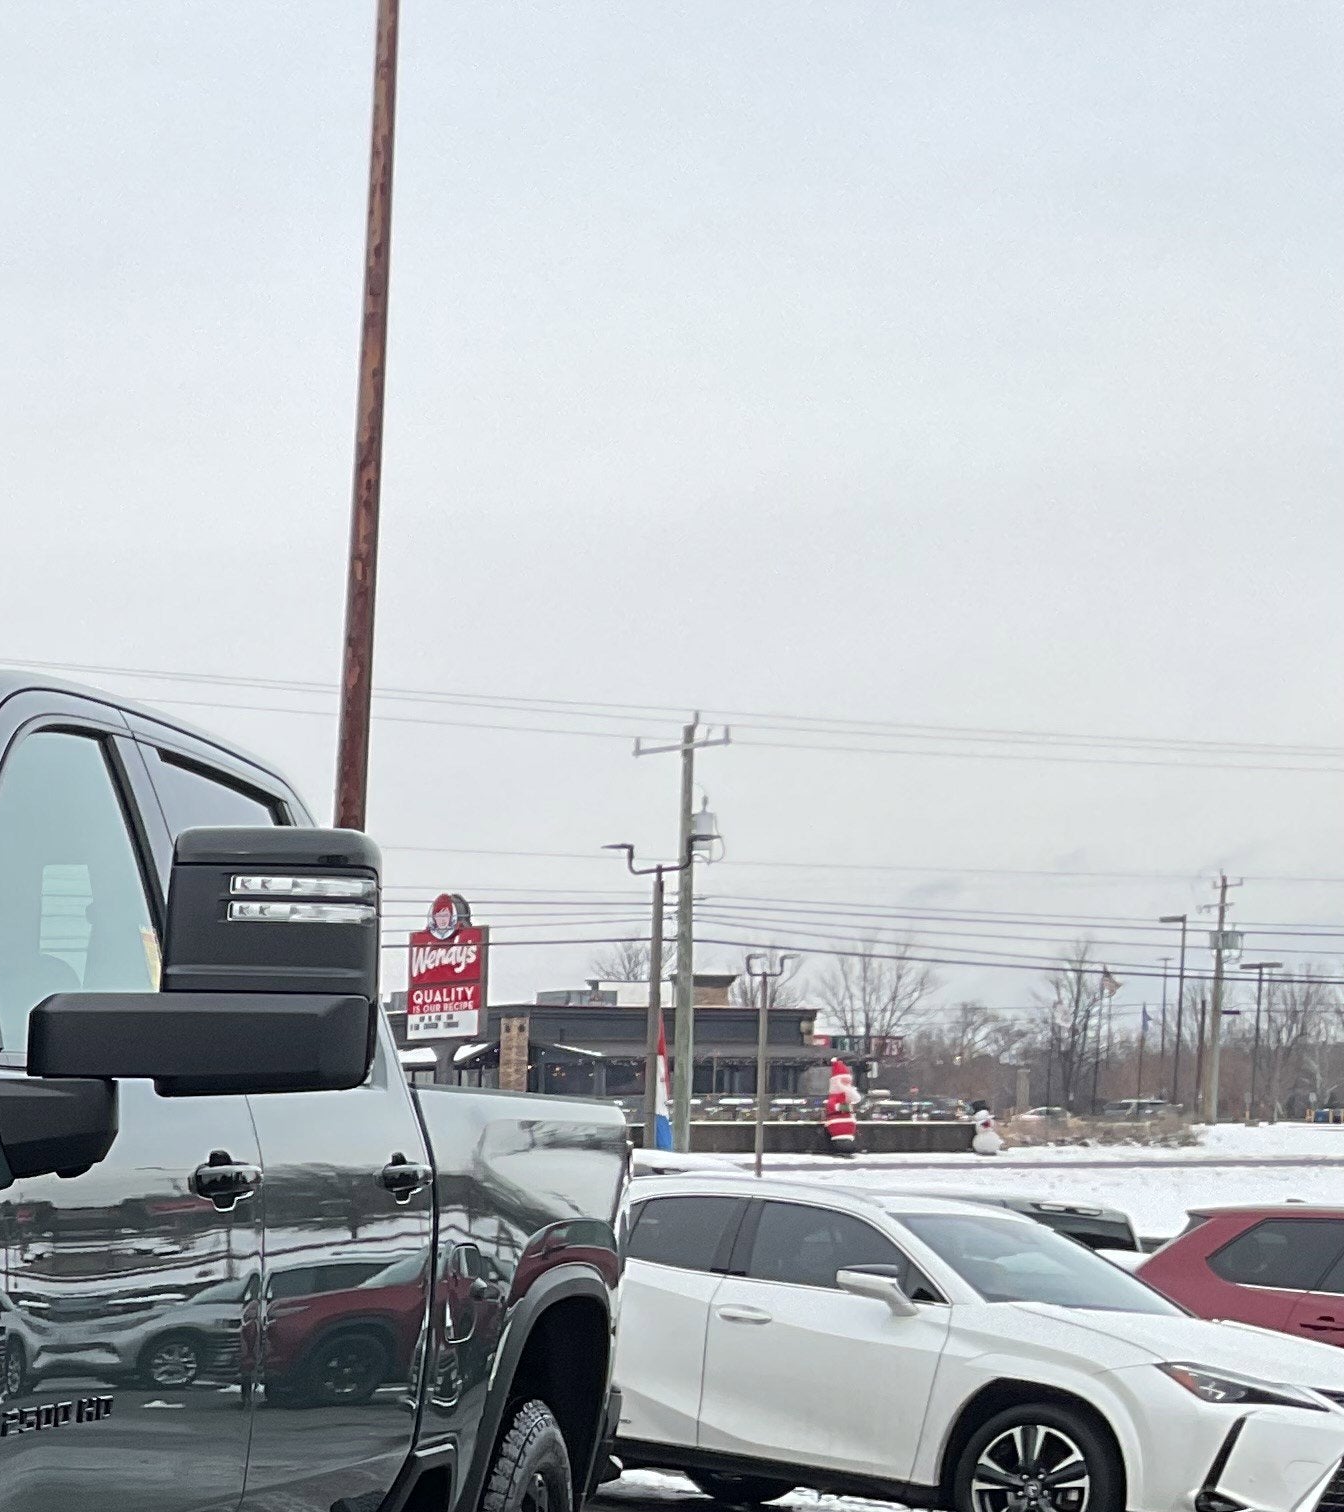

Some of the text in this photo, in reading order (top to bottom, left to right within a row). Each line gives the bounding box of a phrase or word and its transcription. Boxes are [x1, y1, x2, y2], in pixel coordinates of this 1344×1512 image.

[412, 935, 477, 977] Wendy's
[413, 986, 474, 1004] QUALITY
[412, 1000, 474, 1014] IS OUR RECIPE
